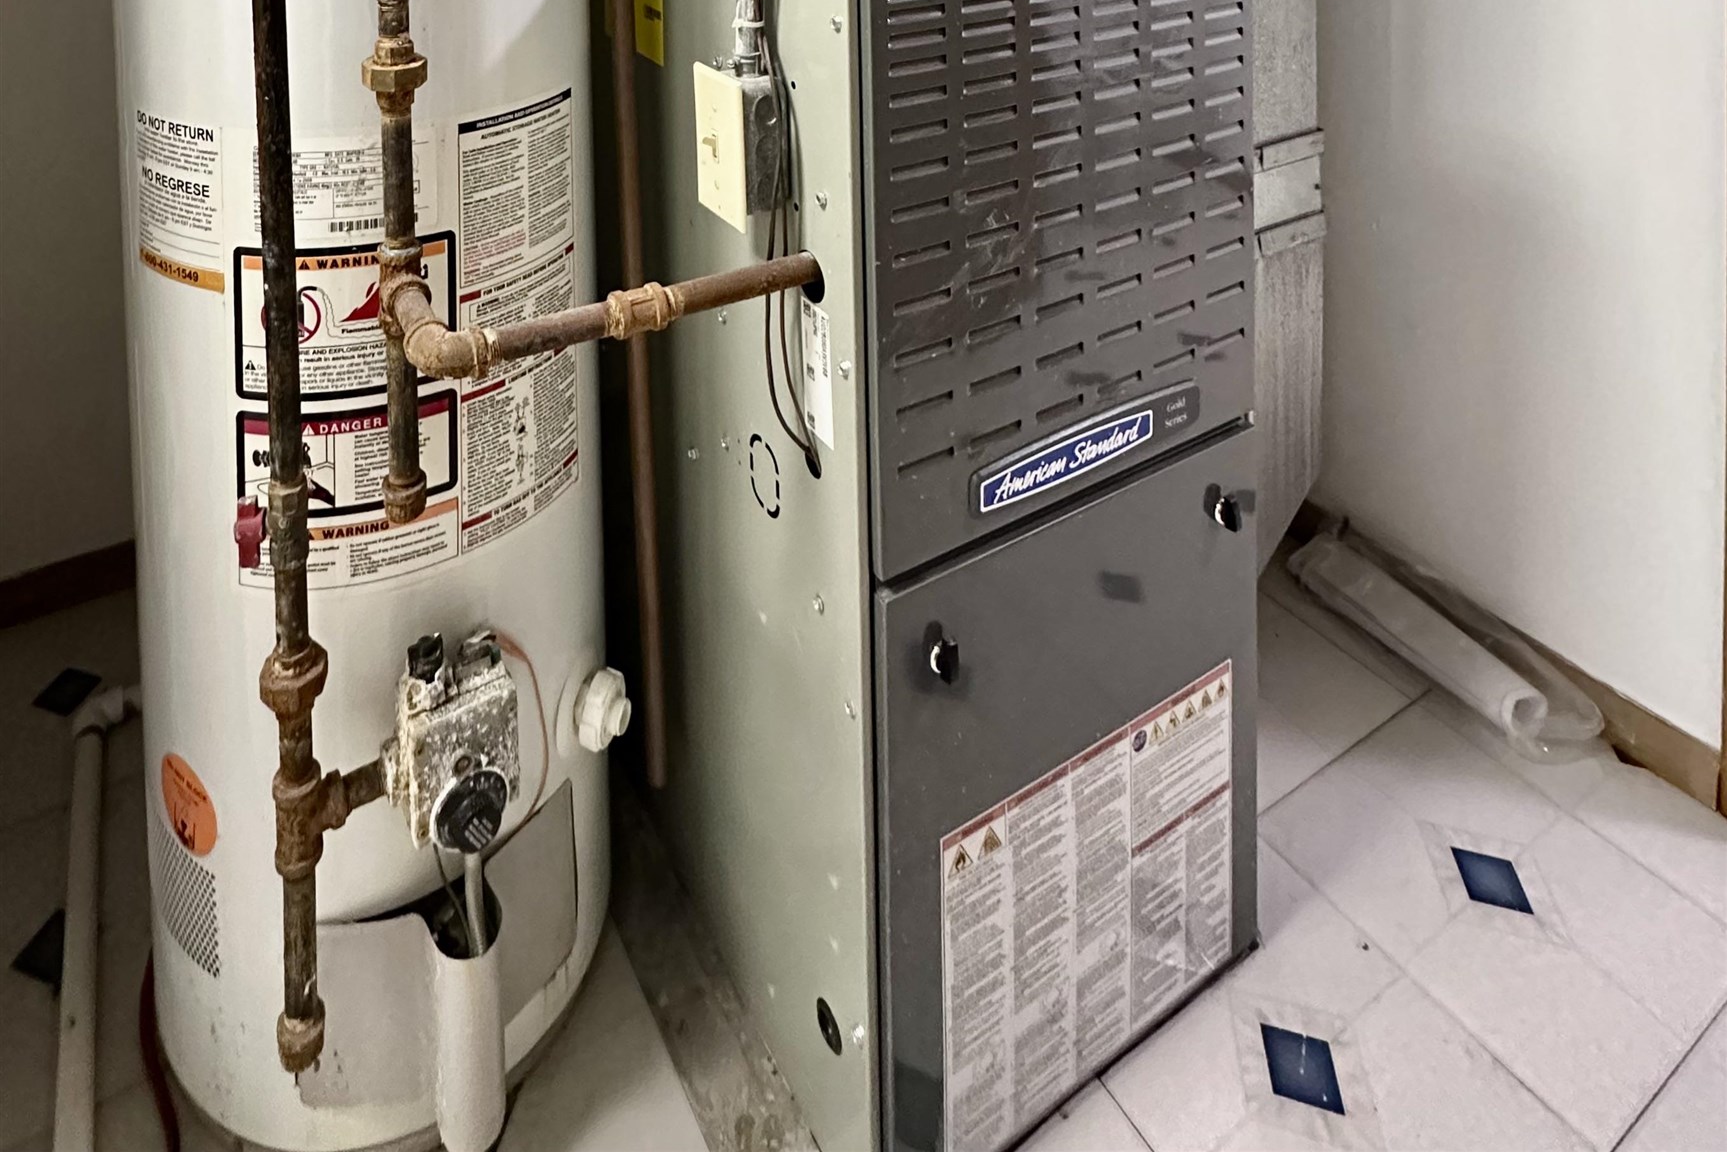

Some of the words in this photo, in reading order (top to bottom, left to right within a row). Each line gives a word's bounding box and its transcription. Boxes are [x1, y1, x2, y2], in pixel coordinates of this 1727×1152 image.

[137, 110, 147, 125] DO
[148, 115, 166, 132] NOT
[168, 121, 214, 142] RETURN
[142, 165, 154, 181] NO
[155, 172, 210, 198] REGRESE
[316, 255, 380, 270] WARNIN
[341, 324, 381, 335] Flammabl
[312, 348, 328, 356] AND
[328, 345, 368, 356] EXPLOSION
[369, 342, 387, 351] HAZA
[1166, 395, 1186, 413] Gold
[319, 417, 383, 435] DANGER
[1164, 412, 1188, 429] Series
[993, 456, 1067, 504] American
[1069, 416, 1142, 469] Standard
[322, 520, 390, 541] WARNING
